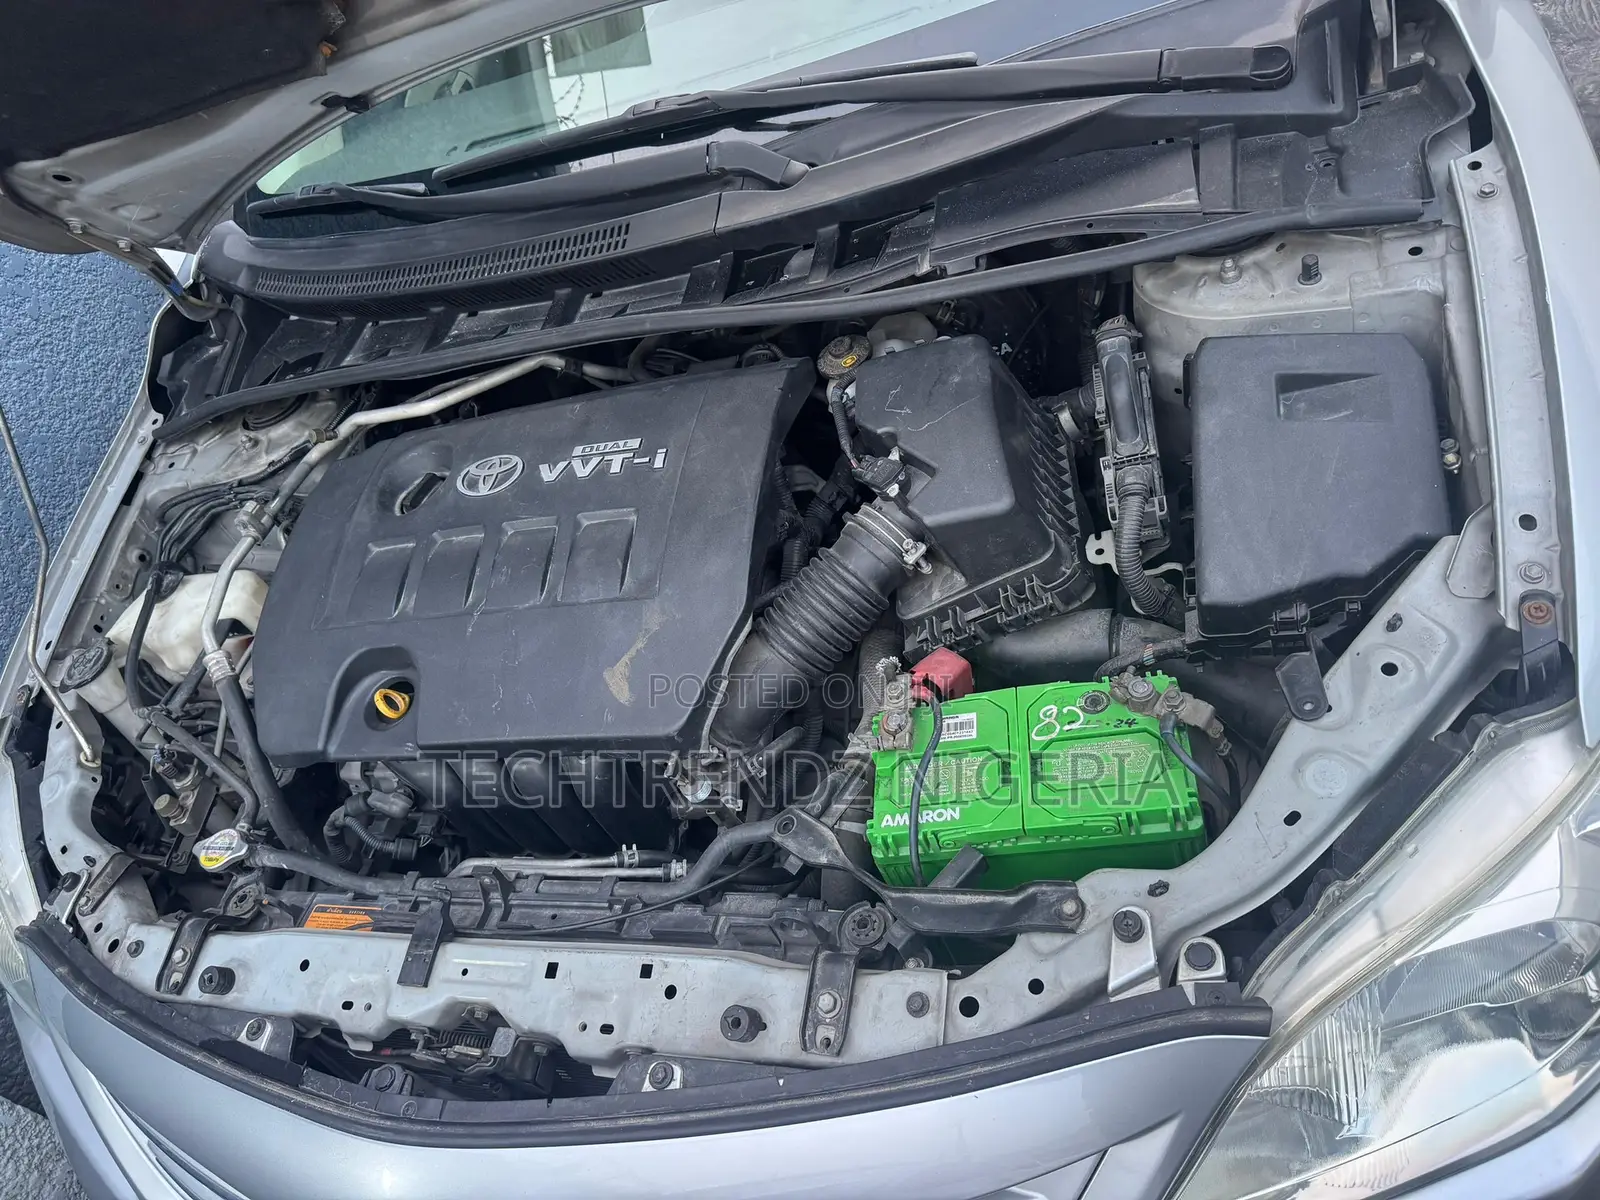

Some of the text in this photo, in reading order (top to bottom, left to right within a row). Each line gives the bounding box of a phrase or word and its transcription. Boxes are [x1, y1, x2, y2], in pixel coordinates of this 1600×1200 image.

[581, 441, 634, 454] DUAL
[538, 448, 668, 482] VVT-i
[1032, 705, 1099, 740] 82
[913, 760, 943, 770] DGER
[951, 757, 983, 766] CAUTION
